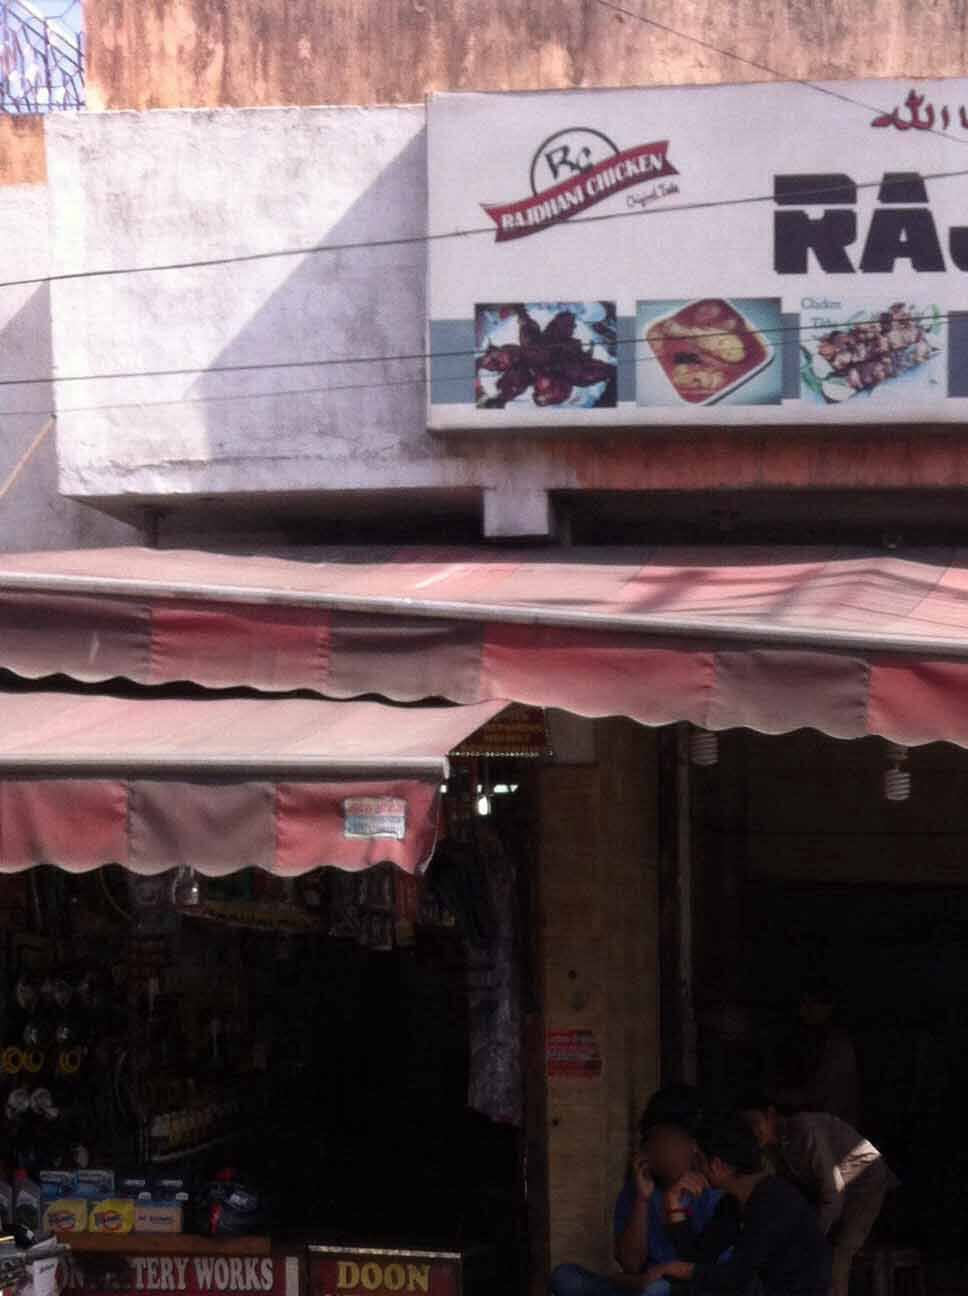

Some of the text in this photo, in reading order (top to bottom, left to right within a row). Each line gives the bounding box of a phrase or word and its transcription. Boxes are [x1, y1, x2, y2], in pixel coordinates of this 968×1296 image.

[501, 152, 665, 232] RAJDHANI CHICKEN
[193, 1257, 275, 1292] WORKS
[336, 1261, 432, 1292] DOON
